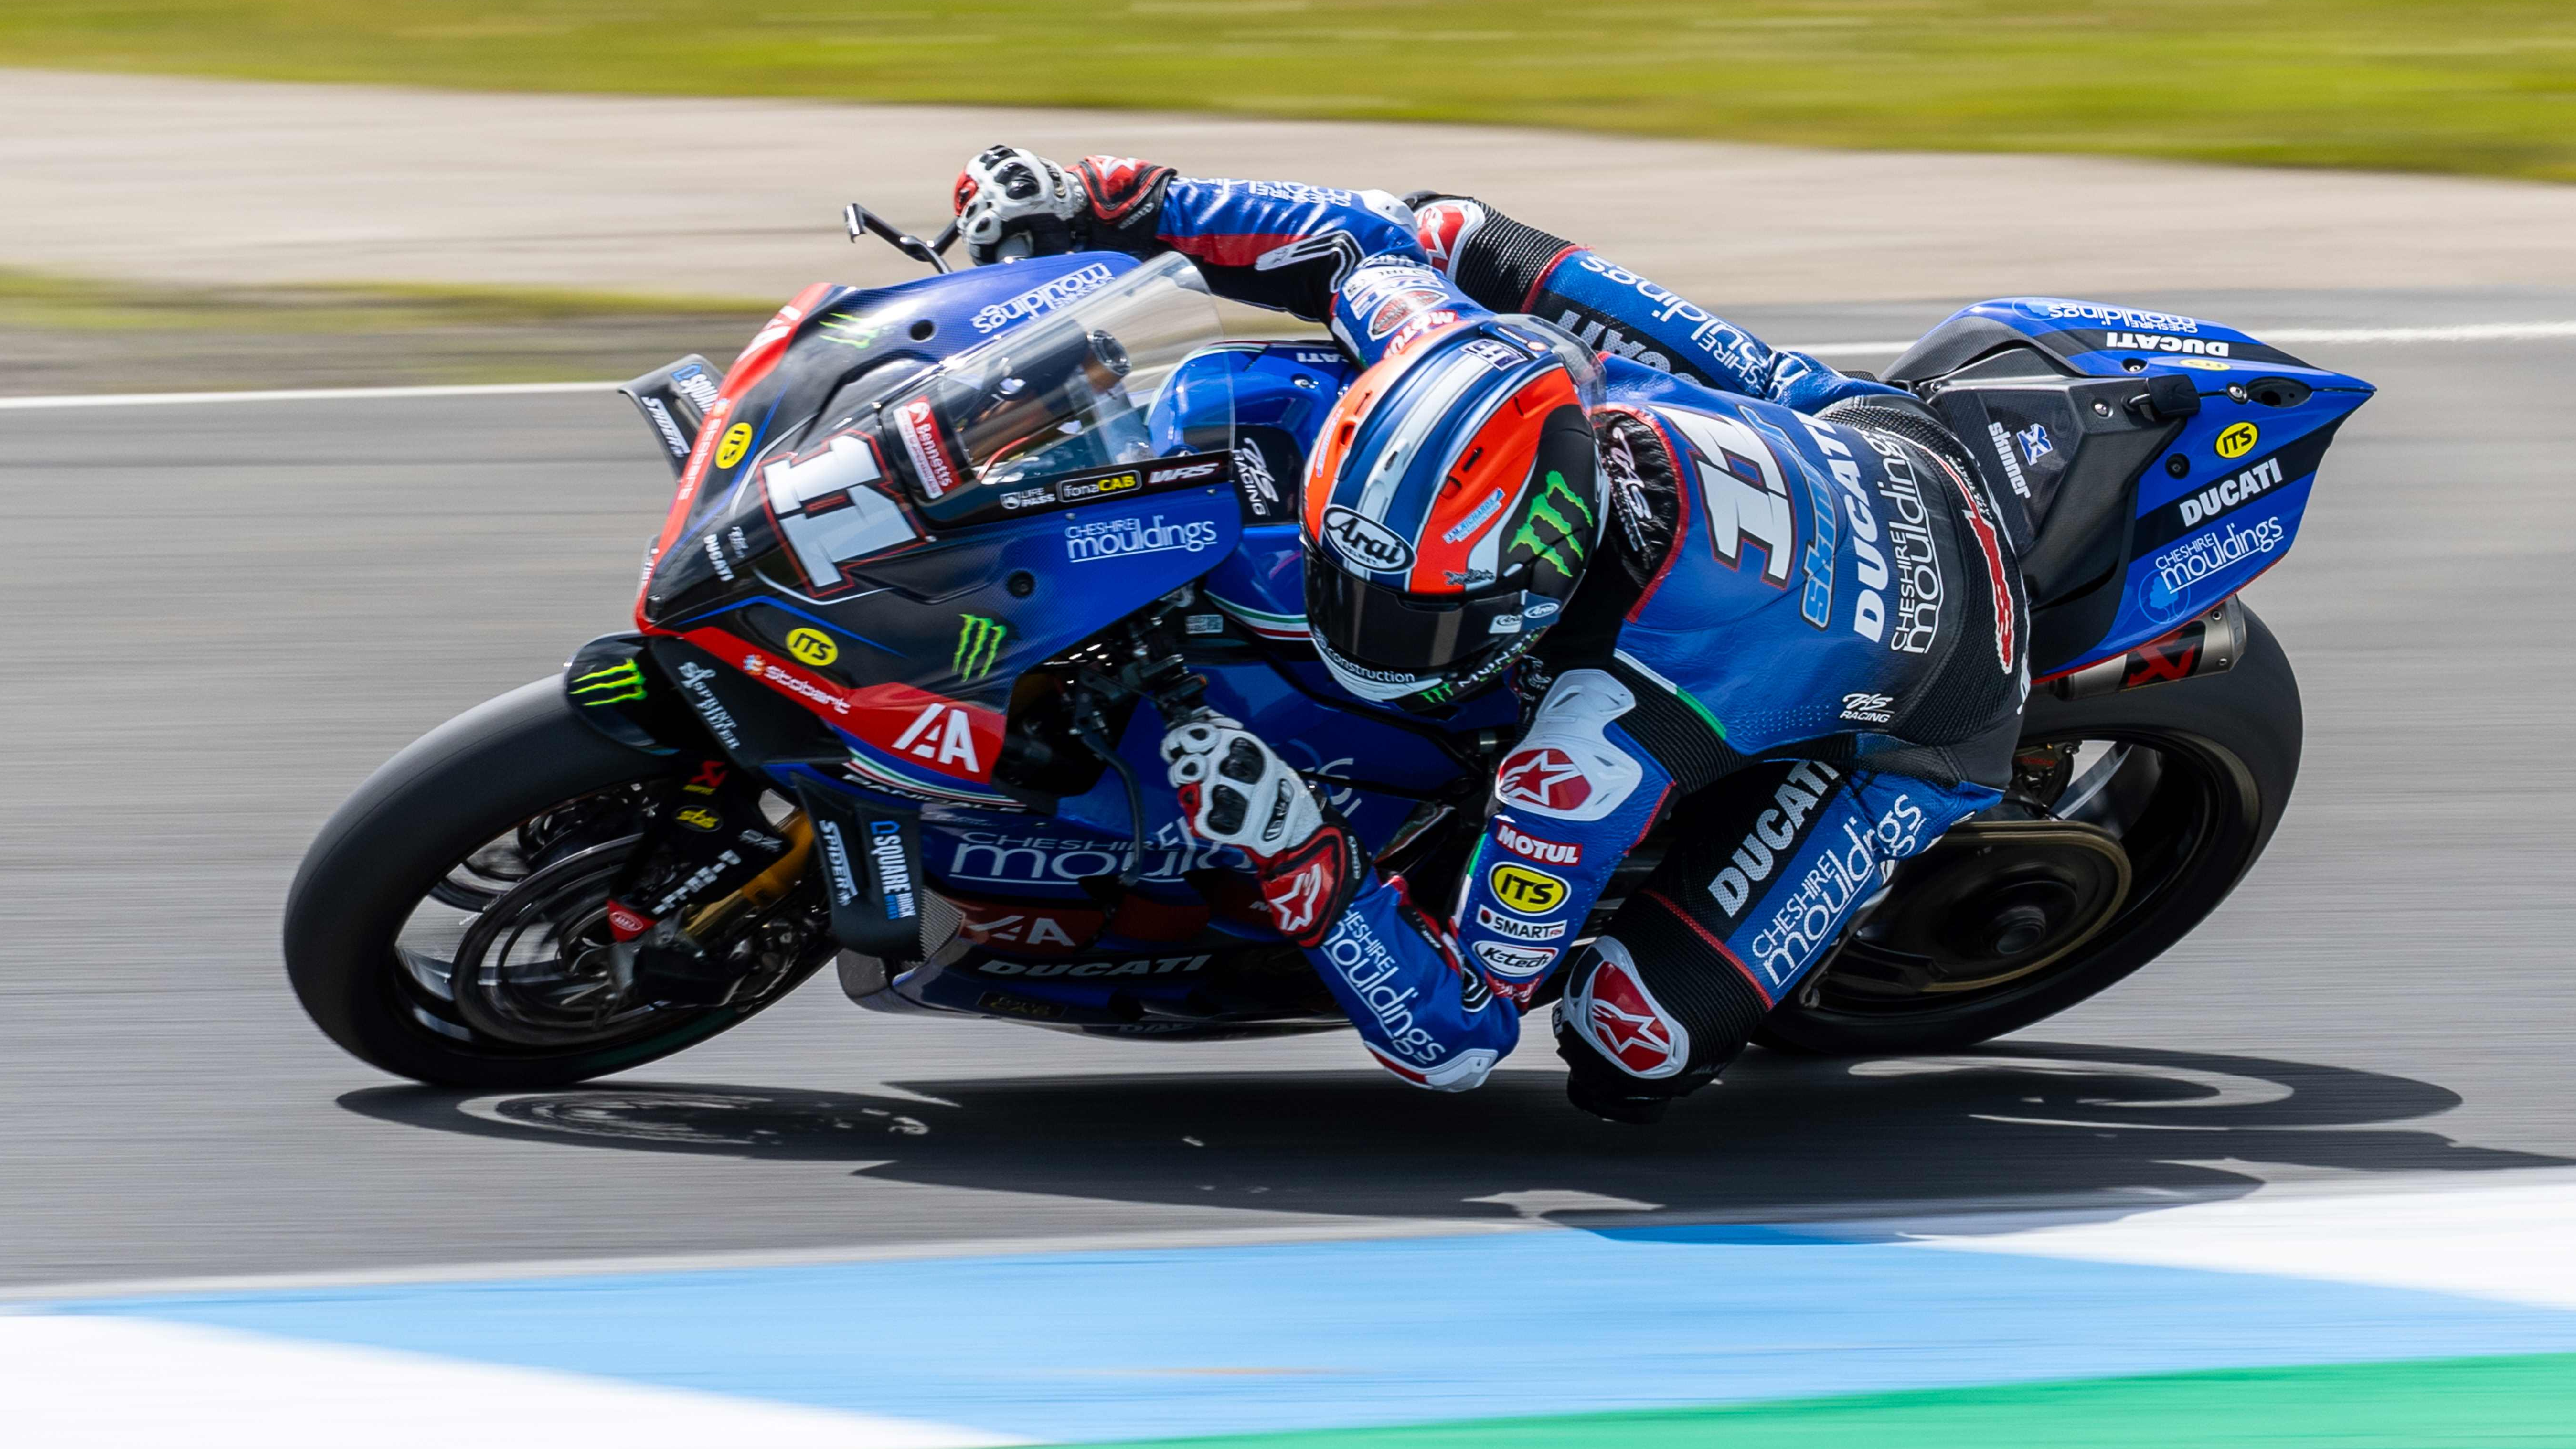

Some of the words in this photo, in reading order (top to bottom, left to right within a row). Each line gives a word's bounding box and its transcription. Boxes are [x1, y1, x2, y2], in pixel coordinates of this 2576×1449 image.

[971, 263, 1113, 333] mouldings
[2048, 303, 2195, 327] mouldings
[2107, 332, 2229, 357] DUCATI
[915, 423, 953, 487] Bennetts
[1988, 422, 2031, 498] skinner
[2222, 426, 2252, 455] ITS
[1021, 493, 1056, 508] PASS
[1022, 487, 1045, 499] LIFE
[2179, 457, 2283, 527] DUCATI
[1065, 518, 1136, 539] CHESHIRE
[1067, 515, 1217, 559] mouldings
[1326, 517, 1403, 564] Arai
[1788, 408, 1889, 643] DUCATI
[703, 534, 734, 581] DUCATI
[2155, 534, 2214, 570] CHESHIRE
[2161, 517, 2283, 590] mouldings
[1890, 530, 1915, 651] CHESHIRE
[793, 633, 831, 661] ITS
[1326, 648, 1415, 682] construction
[764, 666, 851, 714] stobart
[1840, 710, 1891, 723] RACING
[818, 820, 859, 896] SPIDER
[1496, 825, 1579, 864] MOTUL
[1707, 761, 1840, 918] DUCATI
[870, 834, 911, 894] SQUARE
[897, 892, 916, 918] BRICK
[1500, 873, 1554, 905] ITS
[1752, 855, 1835, 958] CHESHIRE
[1344, 903, 1399, 973] HESHIRE
[1493, 916, 1558, 939] SMART
[979, 955, 1212, 976] DUCATI
